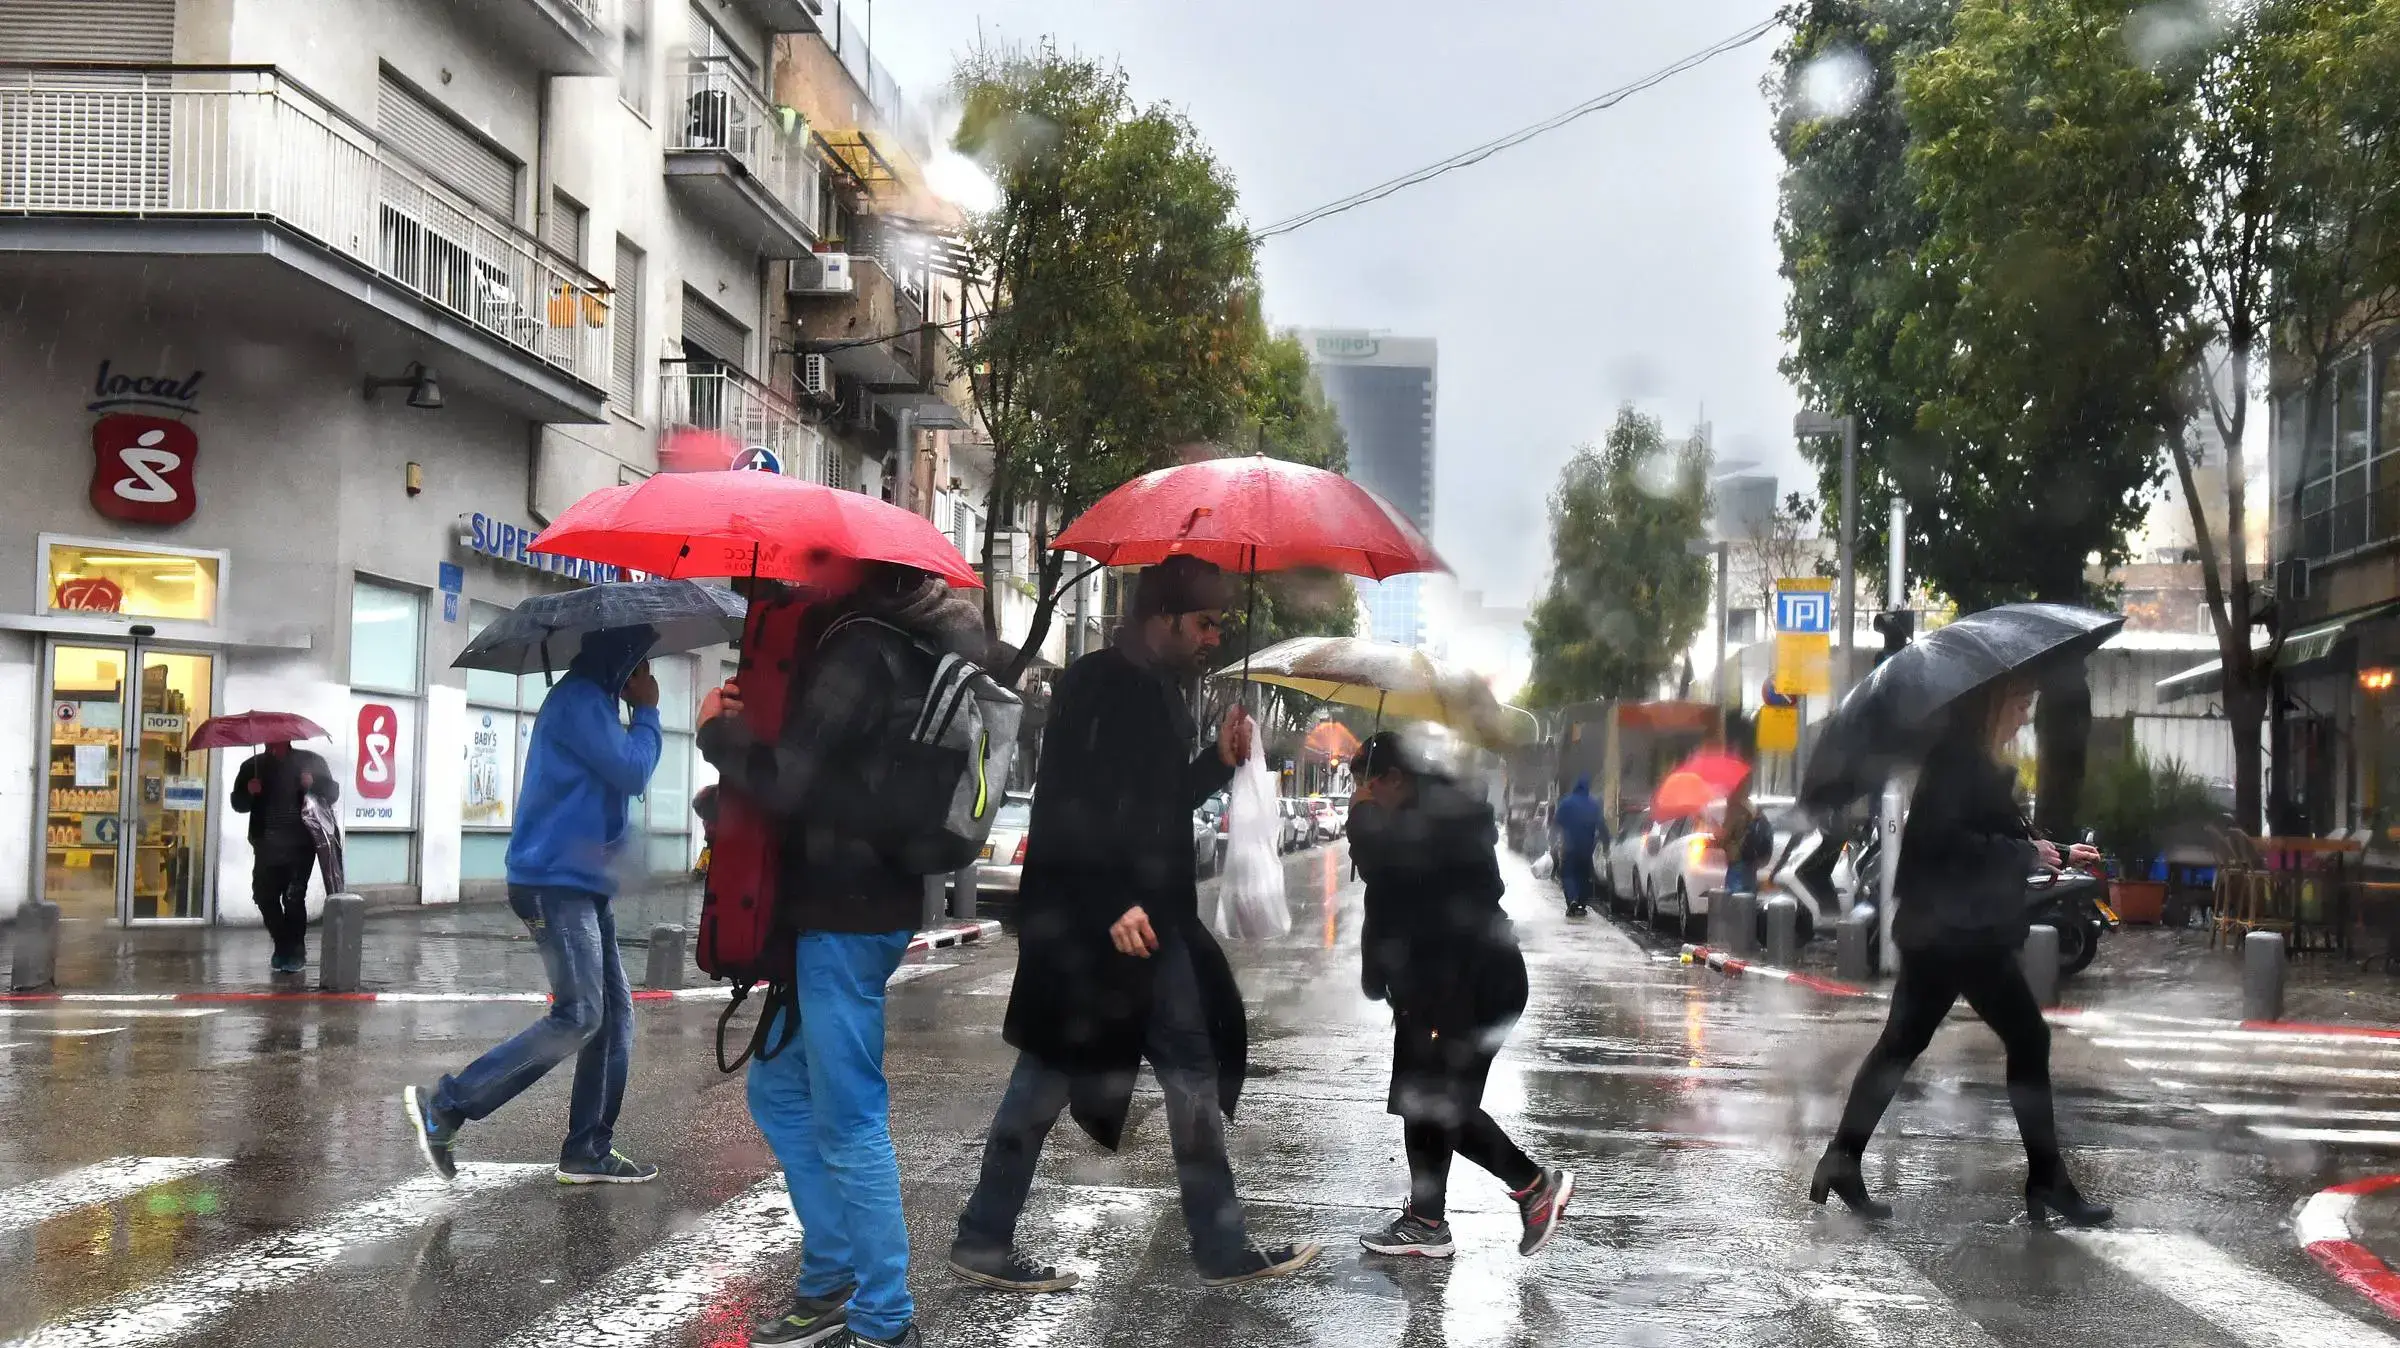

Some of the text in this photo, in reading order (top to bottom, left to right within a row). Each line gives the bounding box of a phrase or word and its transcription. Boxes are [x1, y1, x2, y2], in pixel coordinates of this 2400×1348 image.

[95, 360, 204, 401] local
[148, 717, 178, 729] כניסה
[474, 731, 497, 747] BABY'S
